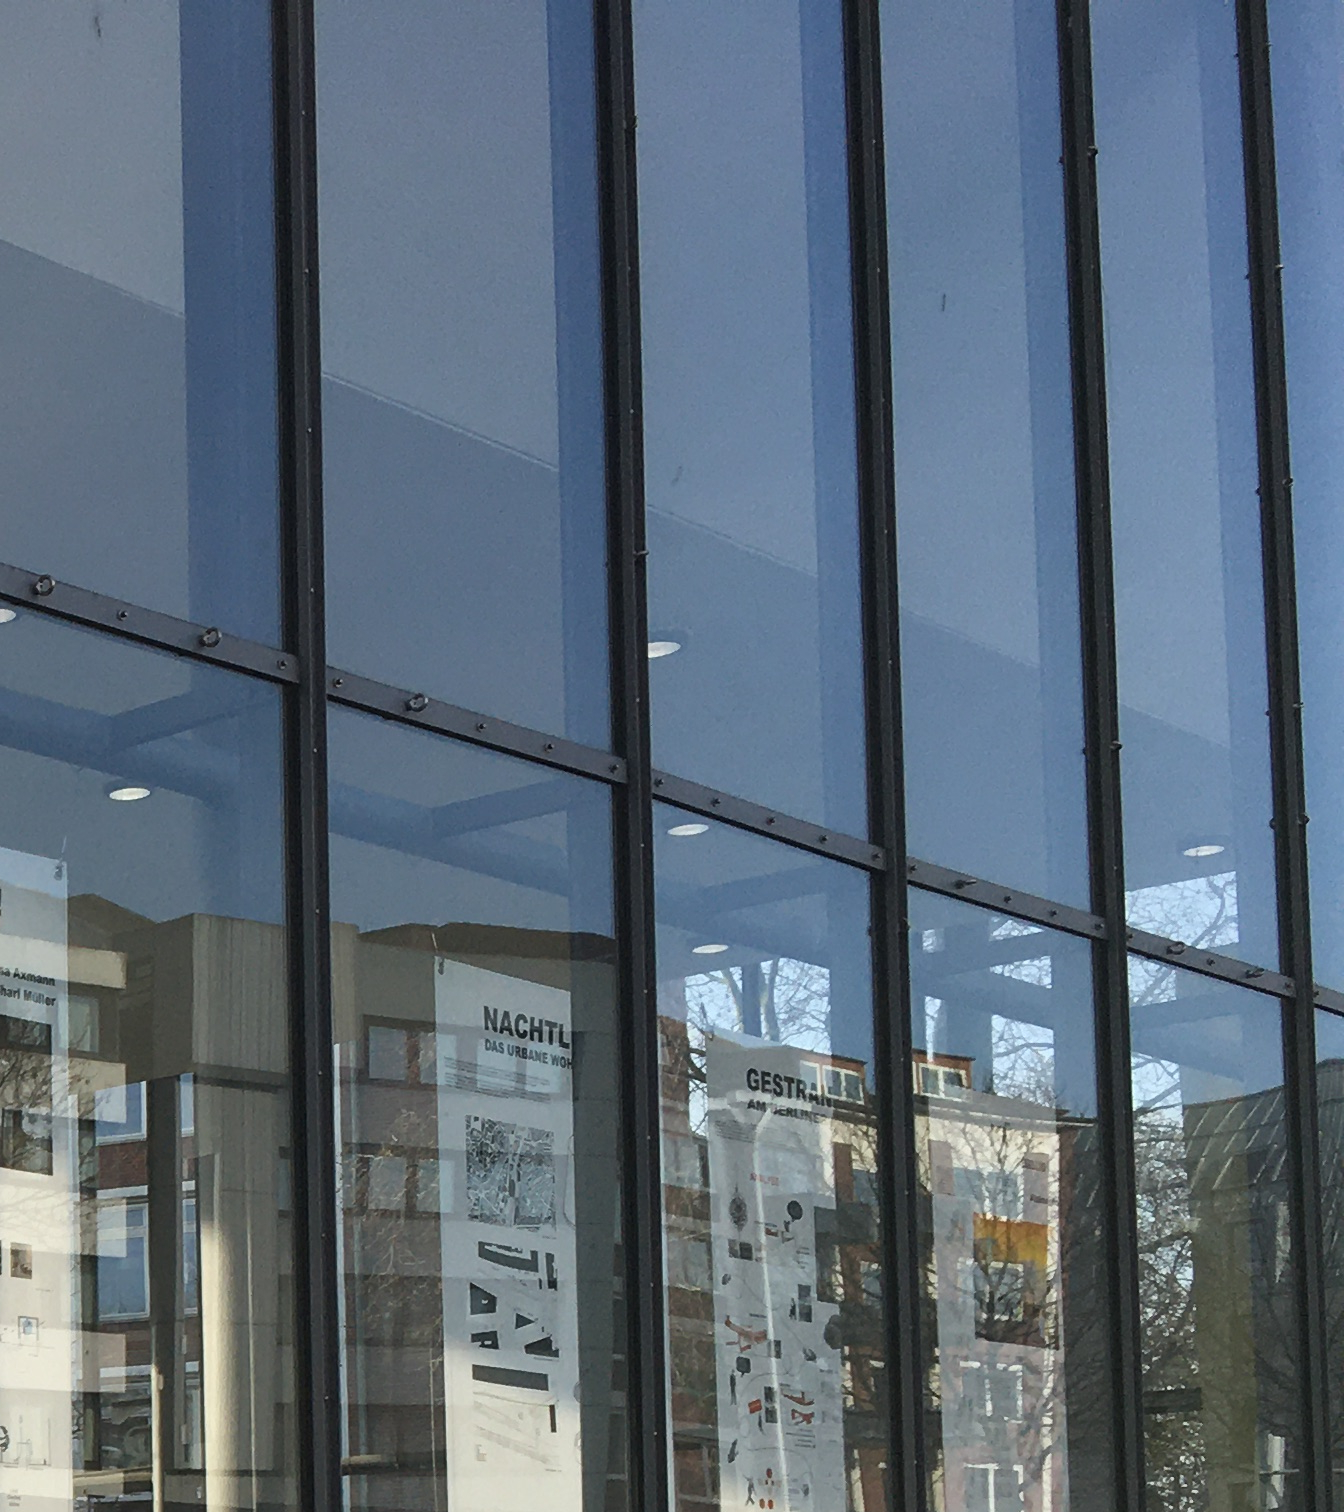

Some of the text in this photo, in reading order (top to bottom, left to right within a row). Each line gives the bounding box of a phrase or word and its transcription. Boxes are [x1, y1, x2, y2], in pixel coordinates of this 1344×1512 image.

[12, 966, 56, 987] Axmann
[484, 1038, 505, 1055] DAS
[507, 1044, 548, 1065] URBANE
